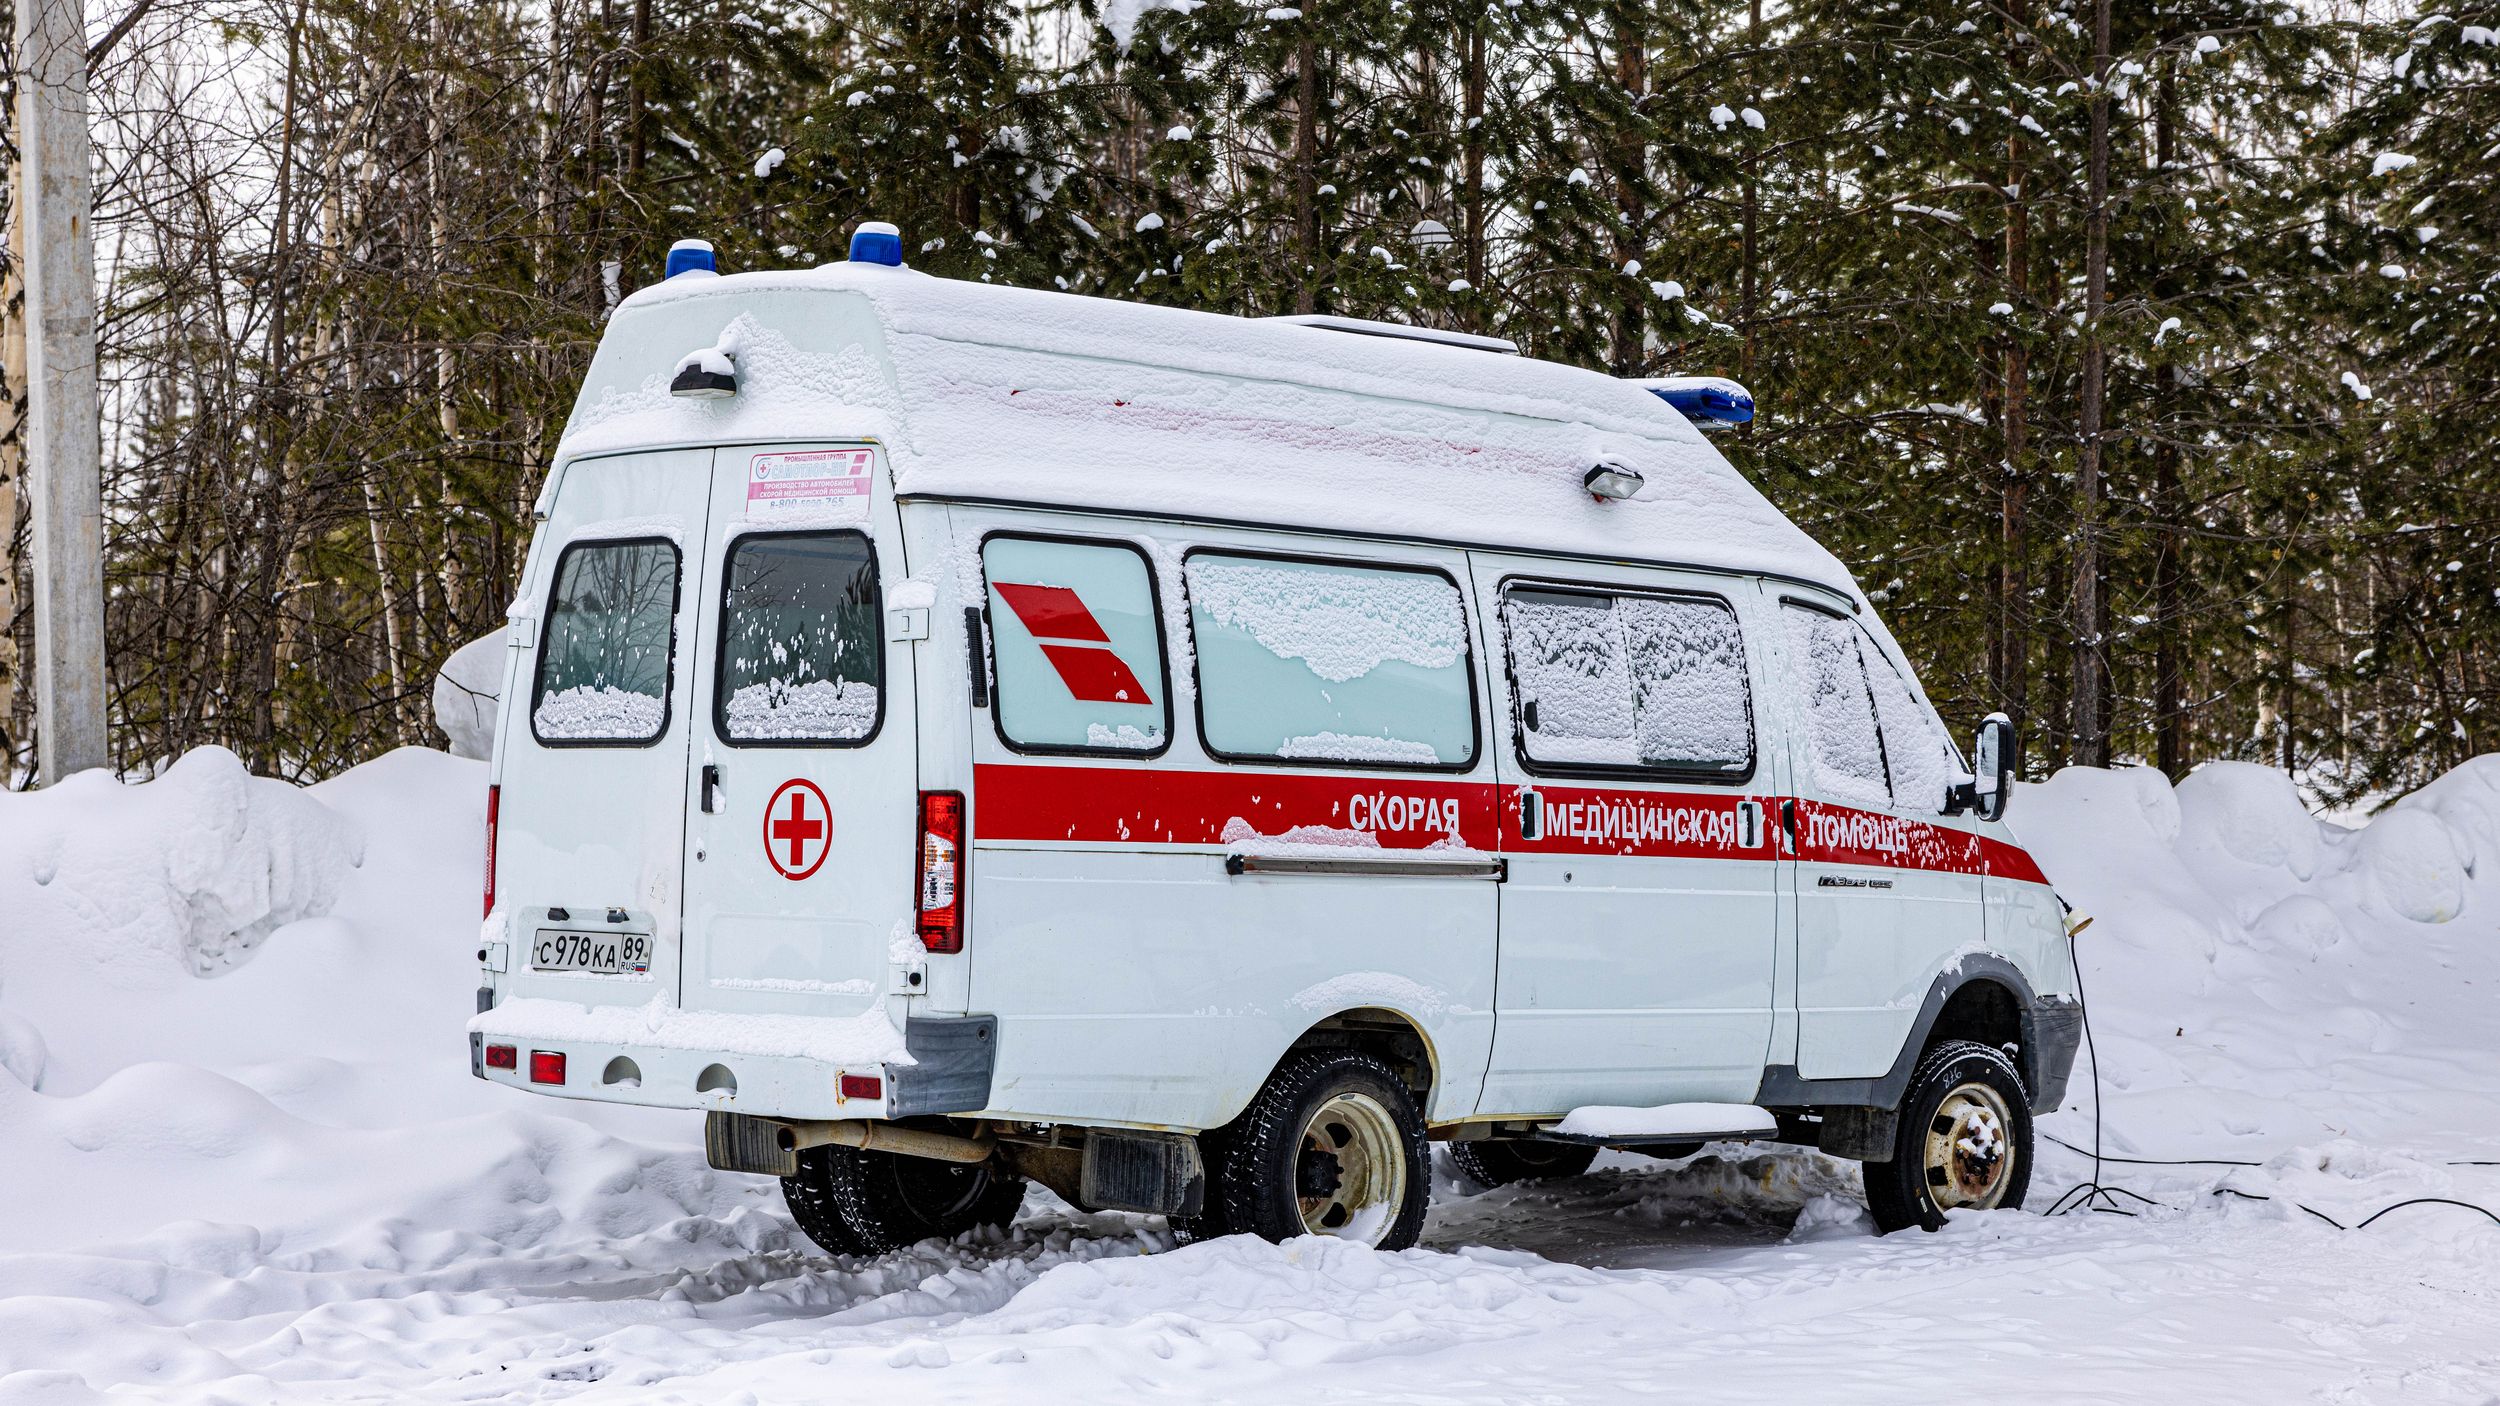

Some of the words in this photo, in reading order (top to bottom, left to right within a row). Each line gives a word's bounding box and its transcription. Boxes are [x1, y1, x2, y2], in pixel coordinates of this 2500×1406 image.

[784, 454, 827, 463] ПРОМЫШЛЕННАЯ
[763, 482, 809, 490] ПРОИЗВОДСТВО
[810, 479, 855, 487] АВТОМОБИЛЕЙ
[760, 490, 783, 498] СКОРОЙ
[784, 488, 828, 497] МЕДИЦИНСКОЙ
[829, 487, 857, 495] ПОМОЩИ
[1349, 794, 1460, 832] СКОРАЯ
[1546, 802, 1735, 845] МЕДИЦИНСКАЯ
[1809, 813, 1908, 857] ПОМОЩЬ
[623, 937, 644, 961] 89
[621, 961, 636, 971] RUS
